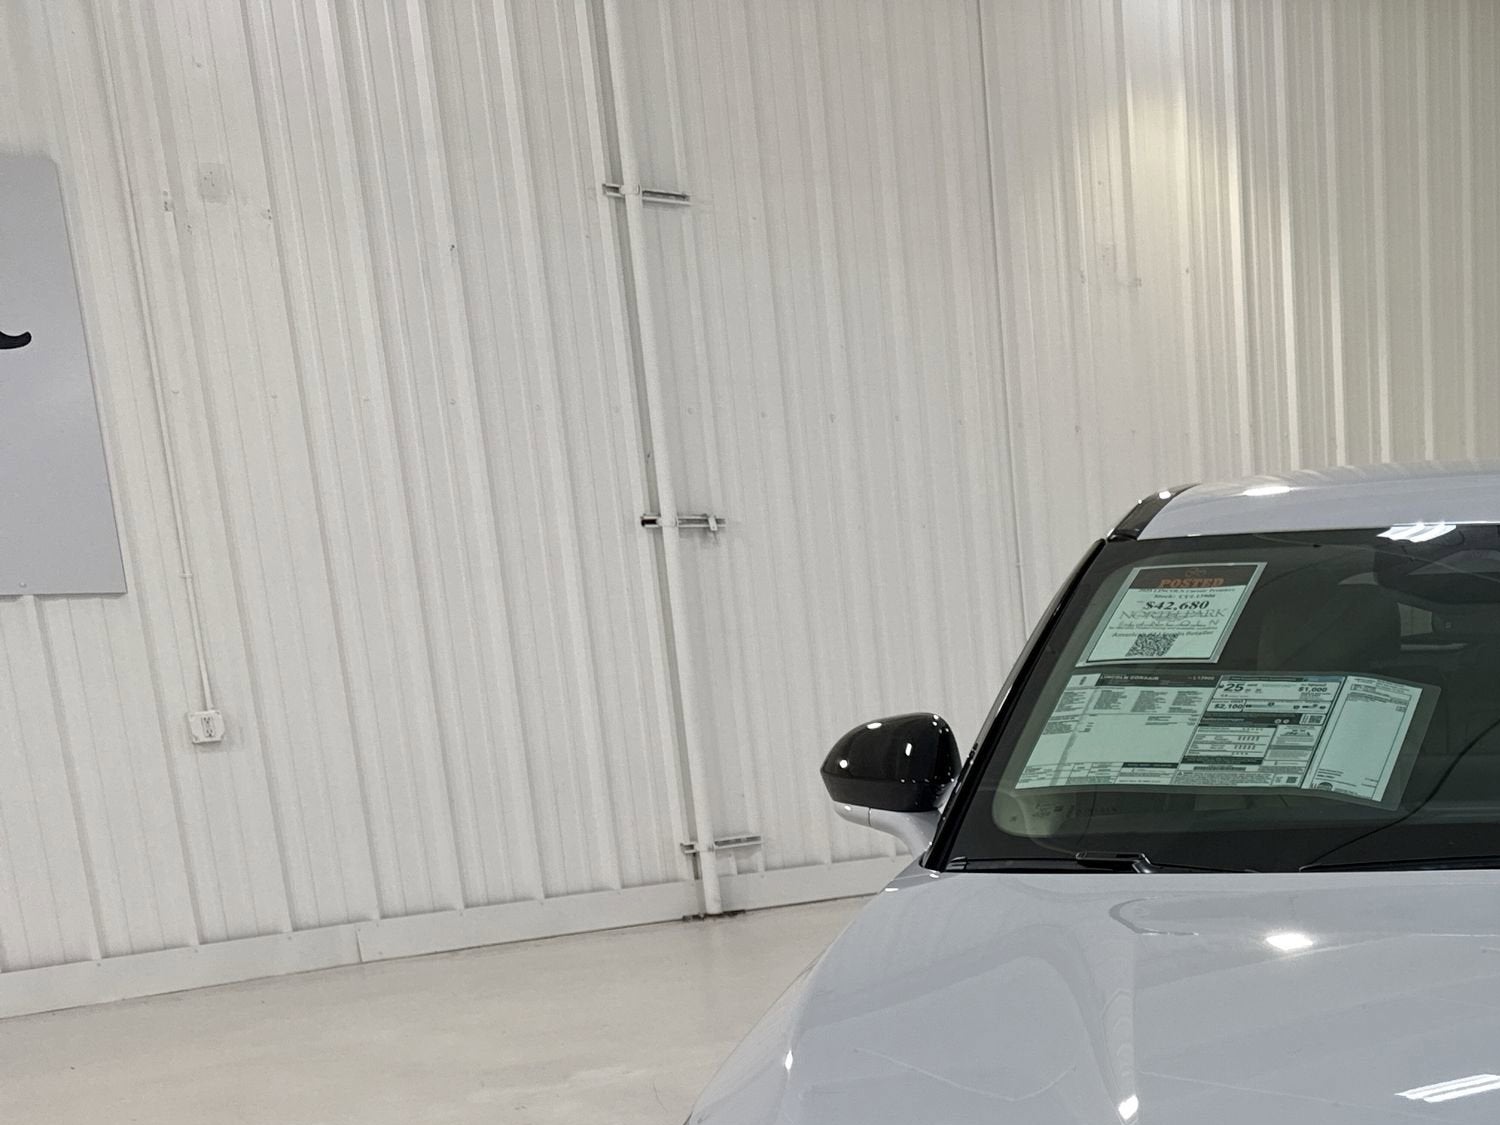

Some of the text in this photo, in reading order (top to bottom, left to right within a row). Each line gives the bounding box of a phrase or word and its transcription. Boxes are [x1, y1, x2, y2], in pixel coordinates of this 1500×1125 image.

[1159, 578, 1224, 588] POSTED
[1144, 601, 1209, 610] $42,680
[1223, 683, 1245, 692] 25
